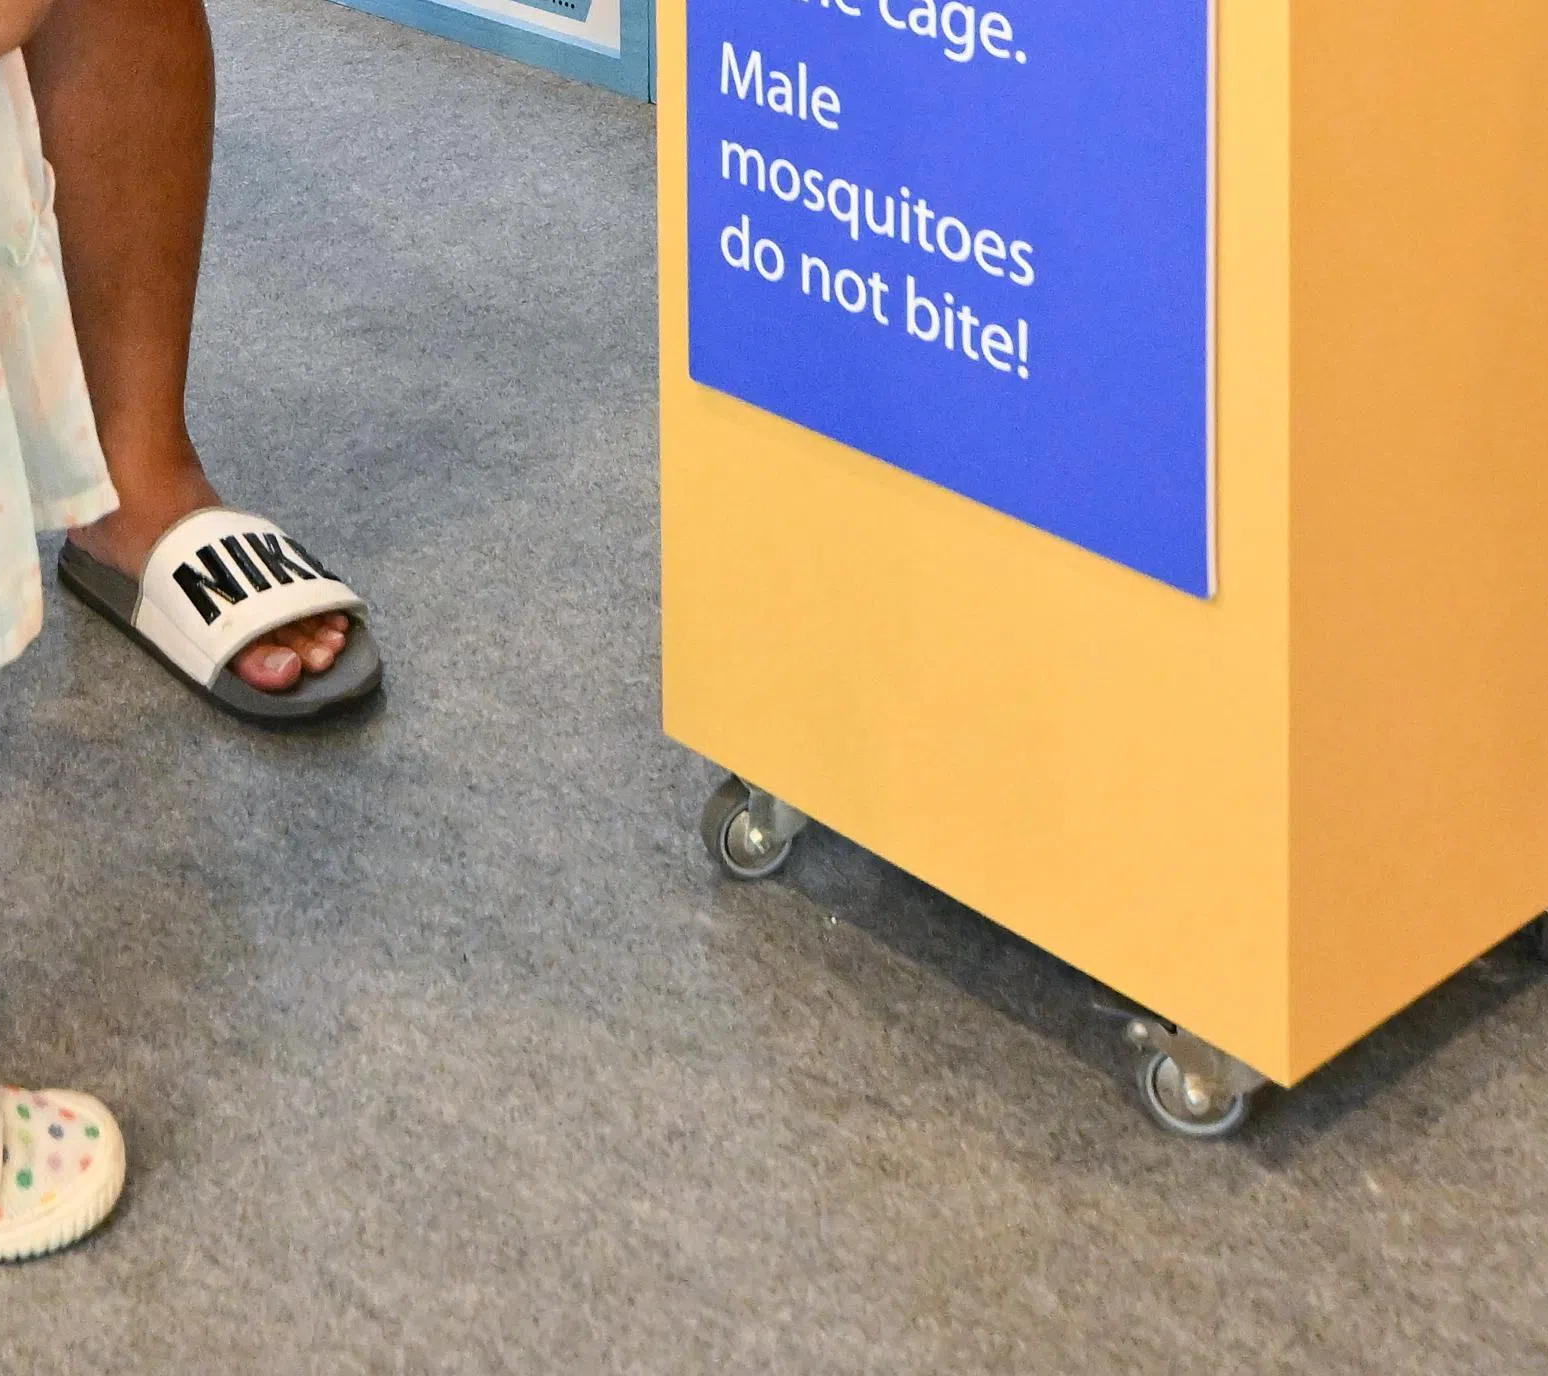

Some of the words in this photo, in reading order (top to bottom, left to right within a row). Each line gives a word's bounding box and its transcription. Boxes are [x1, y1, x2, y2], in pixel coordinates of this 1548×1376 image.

[721, 43, 841, 128] Male
[721, 142, 1035, 287] mosquitoes
[720, 219, 785, 280] do
[801, 255, 888, 326] not
[907, 280, 1031, 379] bite!
